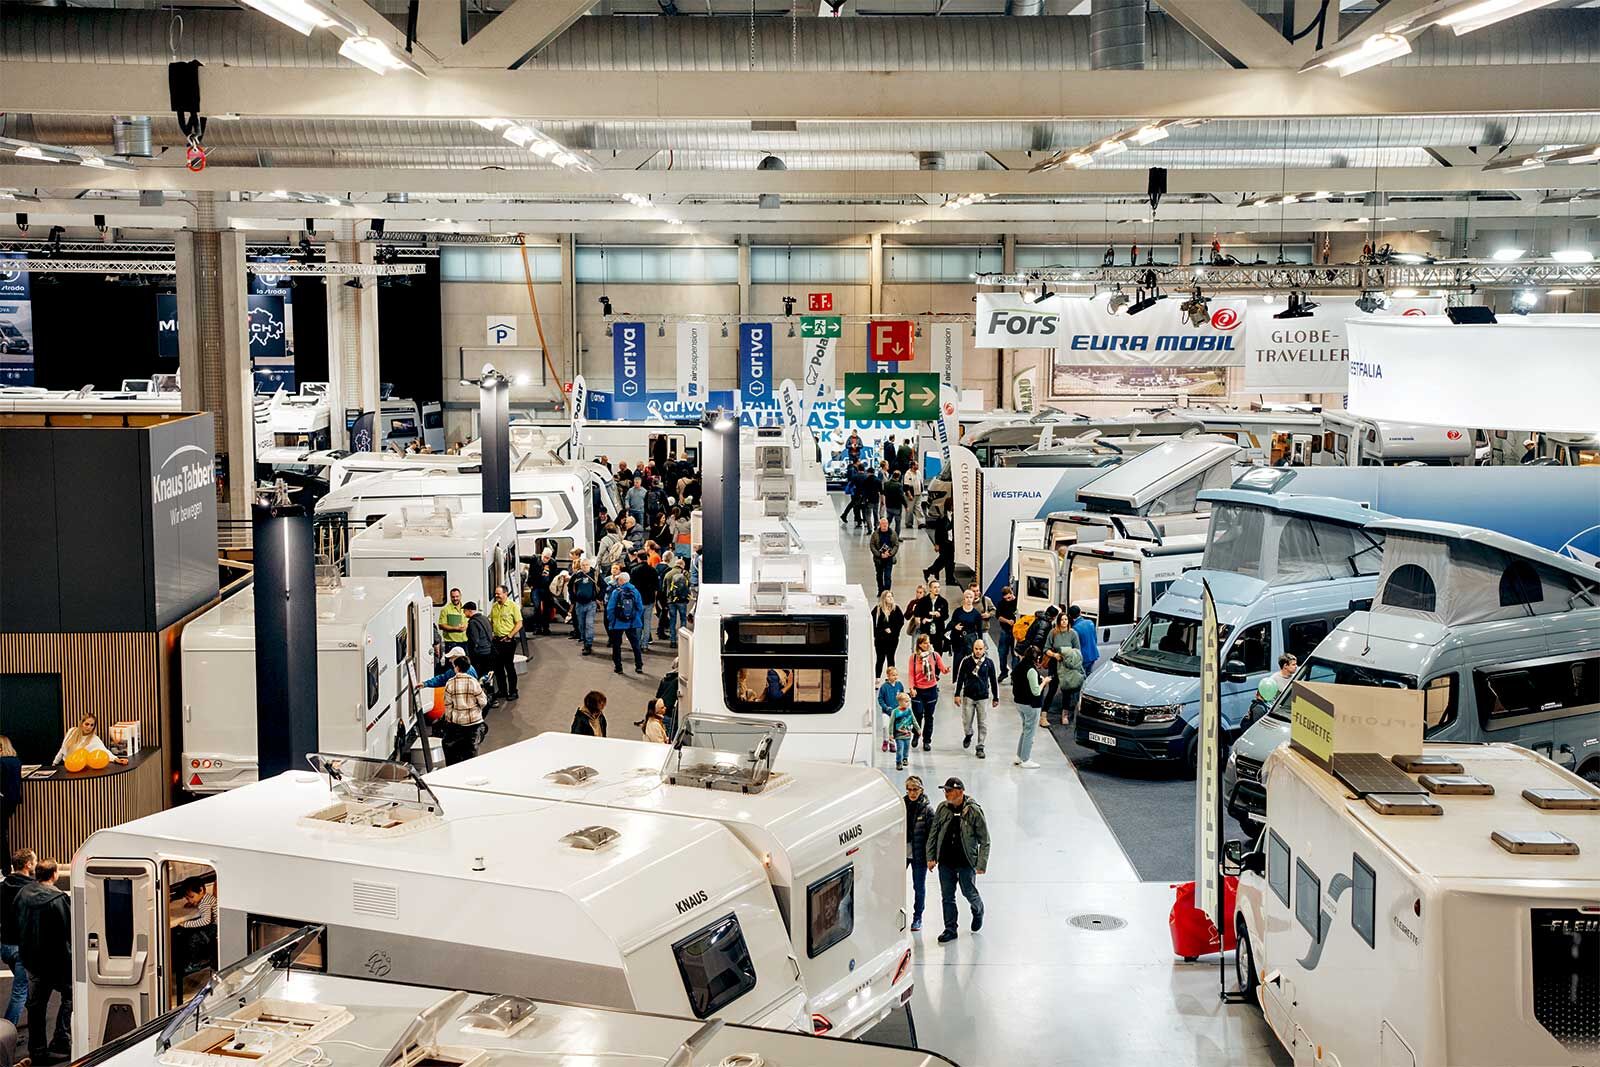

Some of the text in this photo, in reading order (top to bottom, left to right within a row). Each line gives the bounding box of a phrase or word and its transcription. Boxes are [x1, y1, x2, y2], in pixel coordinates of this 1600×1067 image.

[988, 311, 1060, 335] Fors
[496, 329, 507, 344] P
[876, 325, 893, 355] F
[1071, 335, 1236, 351] EURA MOBIL
[1271, 330, 1340, 344] GLOBE-
[1256, 348, 1350, 363] TRAVELLER
[992, 491, 1042, 499] WESTFALIA
[838, 824, 863, 846] KNAUS
[675, 890, 709, 915] KNAUS
